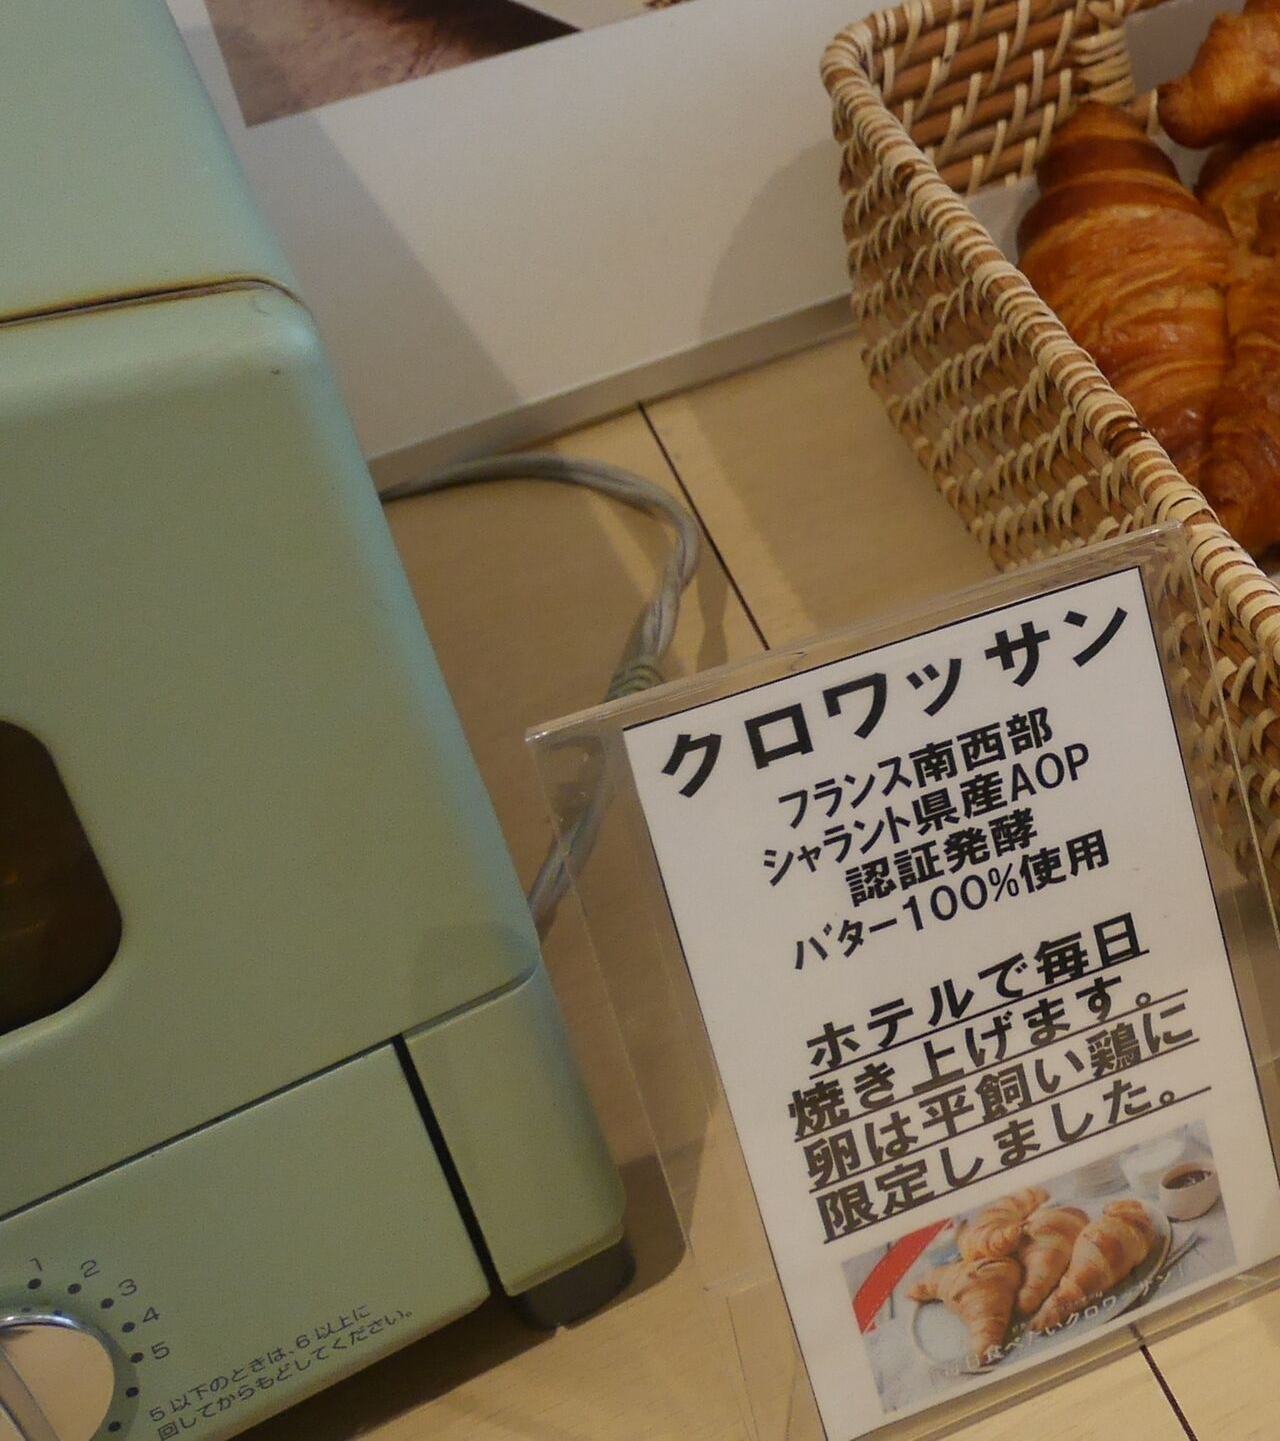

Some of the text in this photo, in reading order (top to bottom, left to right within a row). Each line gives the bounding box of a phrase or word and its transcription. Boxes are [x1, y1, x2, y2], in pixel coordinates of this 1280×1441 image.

[660, 605, 1128, 798] クロワッサン
[778, 705, 1053, 828] フランス南西部
[762, 741, 1091, 886] シャラント県産AOP
[846, 807, 1038, 908] 認証発酵
[794, 828, 1111, 970] バター100%使用
[788, 975, 1152, 1136] 焼き上げます。
[806, 913, 1142, 1070] ホテルで毎日
[803, 1002, 1195, 1186] 卵は平飼い鶏に
[817, 1081, 1175, 1240] 限定しました。
[30, 1257, 43, 1272] 1
[80, 1258, 101, 1278] 2
[118, 1278, 138, 1297] 3
[141, 1306, 161, 1324] 4
[151, 1341, 171, 1360] 5
[157, 1310, 414, 1441] 回してからもどしてください。
